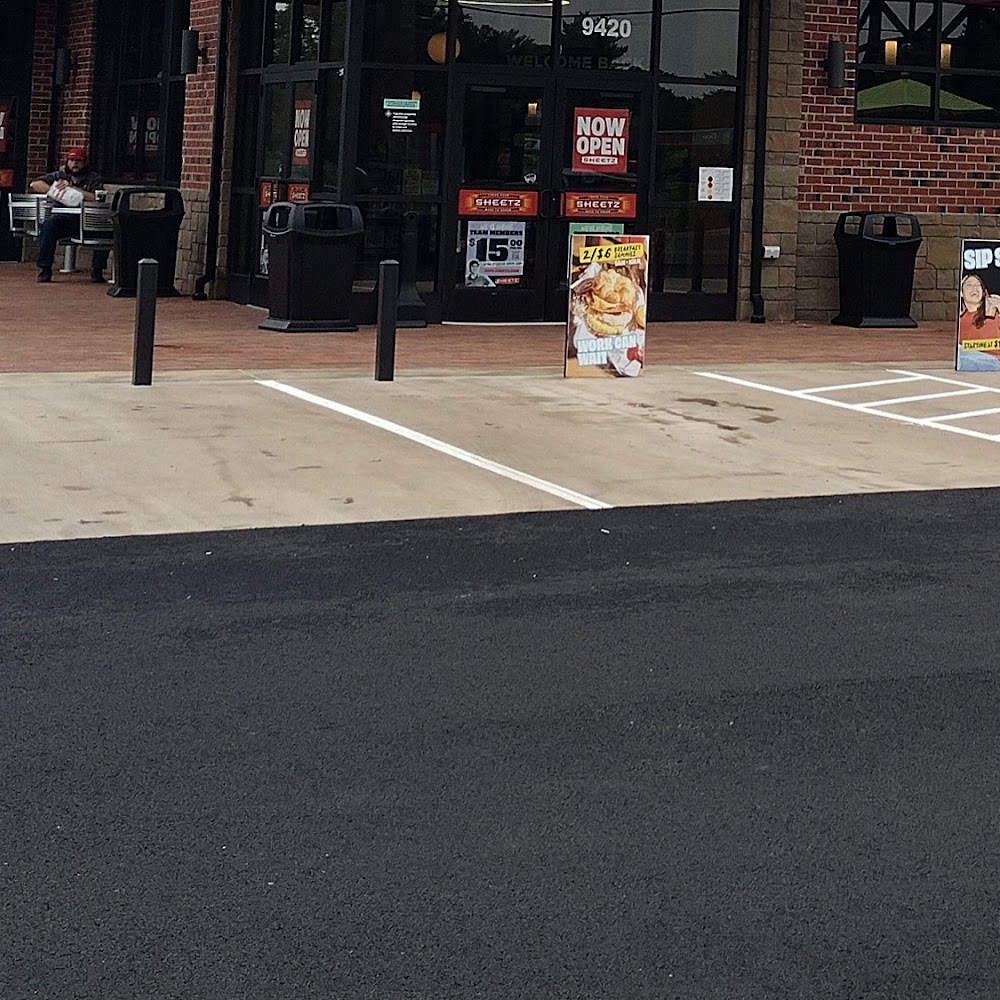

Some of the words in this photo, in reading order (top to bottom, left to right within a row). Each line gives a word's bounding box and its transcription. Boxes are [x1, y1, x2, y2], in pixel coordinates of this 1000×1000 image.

[581, 17, 632, 38] 9420
[576, 116, 626, 137] NOW
[576, 136, 625, 156] OPEN
[475, 198, 521, 207] SHEETZ
[576, 200, 621, 209] SHEETZ
[583, 247, 612, 261] 2/$6
[963, 247, 993, 270] SIP
[577, 337, 613, 353] WORK
[614, 334, 637, 349] CAN
[577, 352, 608, 366] WAIT
